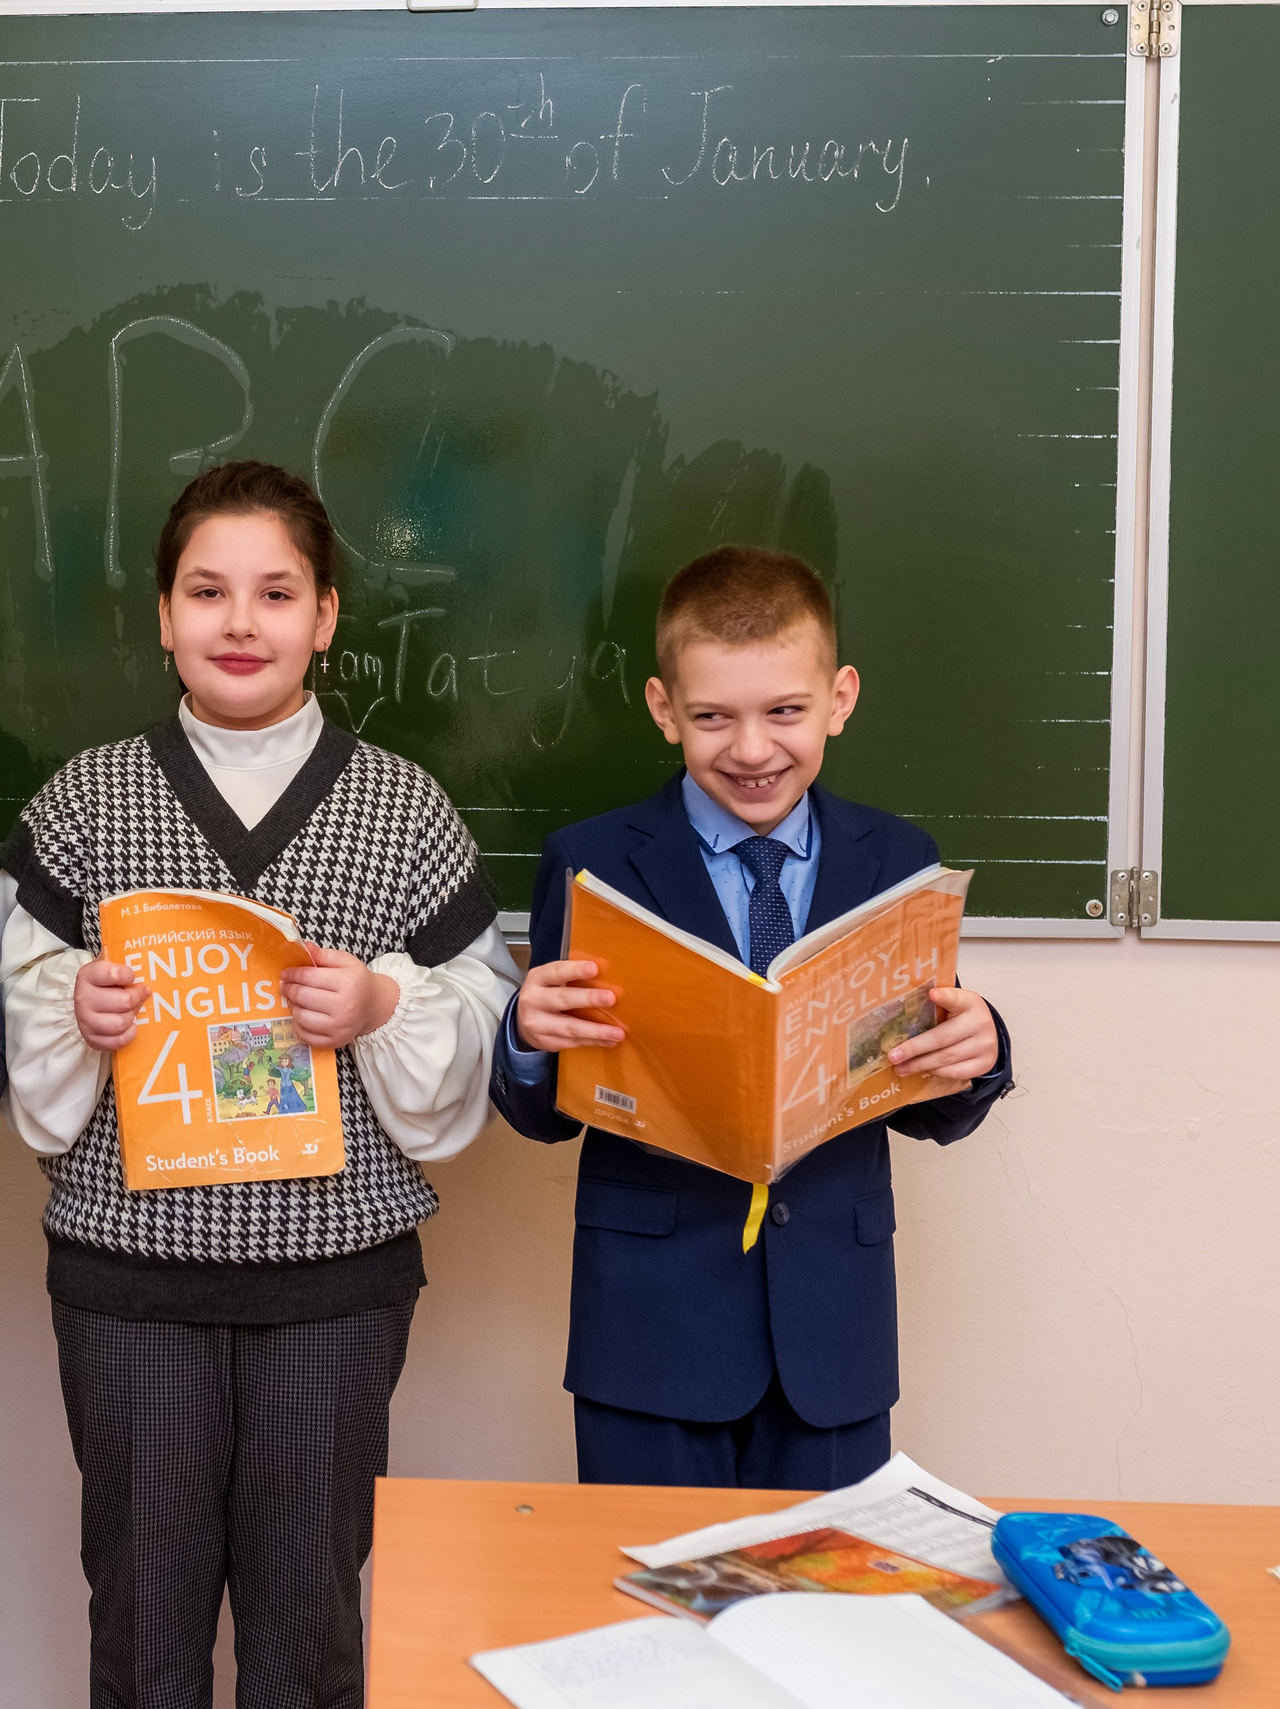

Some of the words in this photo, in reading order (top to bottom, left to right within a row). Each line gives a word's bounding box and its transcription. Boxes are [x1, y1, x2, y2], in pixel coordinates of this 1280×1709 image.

[213, 129, 269, 197] is
[295, 84, 409, 192] the
[565, 83, 648, 194] of
[124, 928, 216, 951] АНГЛИЙСКИЙ
[219, 930, 254, 941] ЯЗЫК
[143, 902, 203, 913] Биболетова
[125, 943, 254, 984] ENJOY
[785, 941, 901, 1035] ENJOY
[784, 947, 938, 1061] ENGLISH
[137, 1030, 203, 1125] 4
[205, 1097, 213, 1122] КЛАСС
[782, 1042, 838, 1113] 4
[783, 1107, 855, 1152] Student's
[859, 1082, 901, 1111] Book
[146, 1148, 228, 1173] Student's
[233, 1144, 280, 1165] Book
